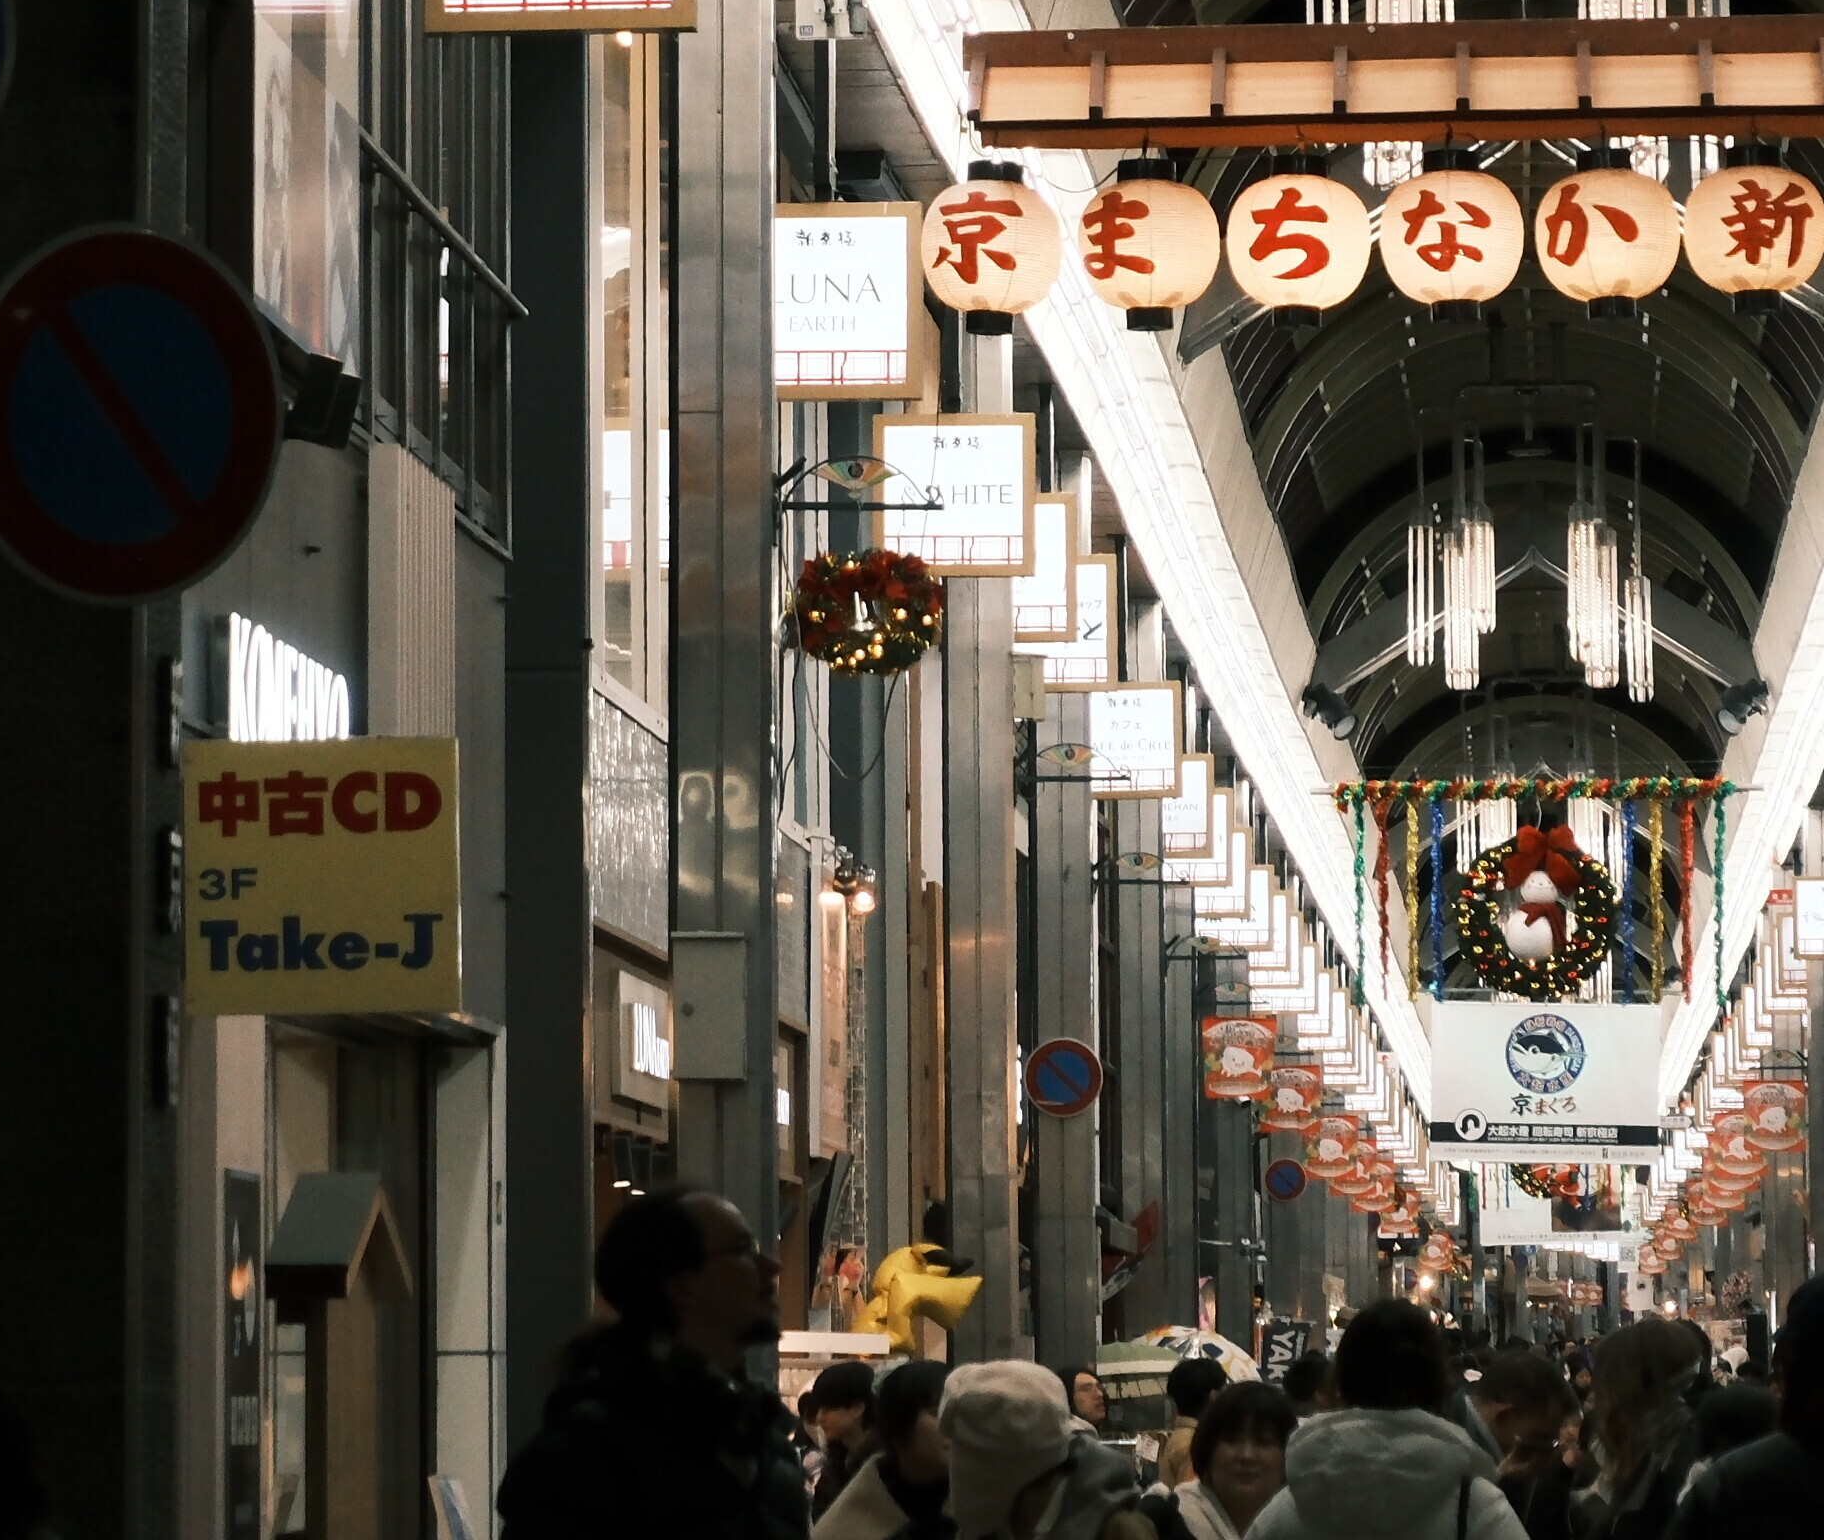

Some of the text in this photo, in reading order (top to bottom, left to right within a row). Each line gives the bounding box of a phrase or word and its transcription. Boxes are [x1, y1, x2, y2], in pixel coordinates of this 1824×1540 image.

[198, 771, 442, 837] 中古CD
[199, 868, 258, 900] 3F
[200, 913, 443, 972] Take-J
[1510, 1093, 1578, 1117] 京まぐろ
